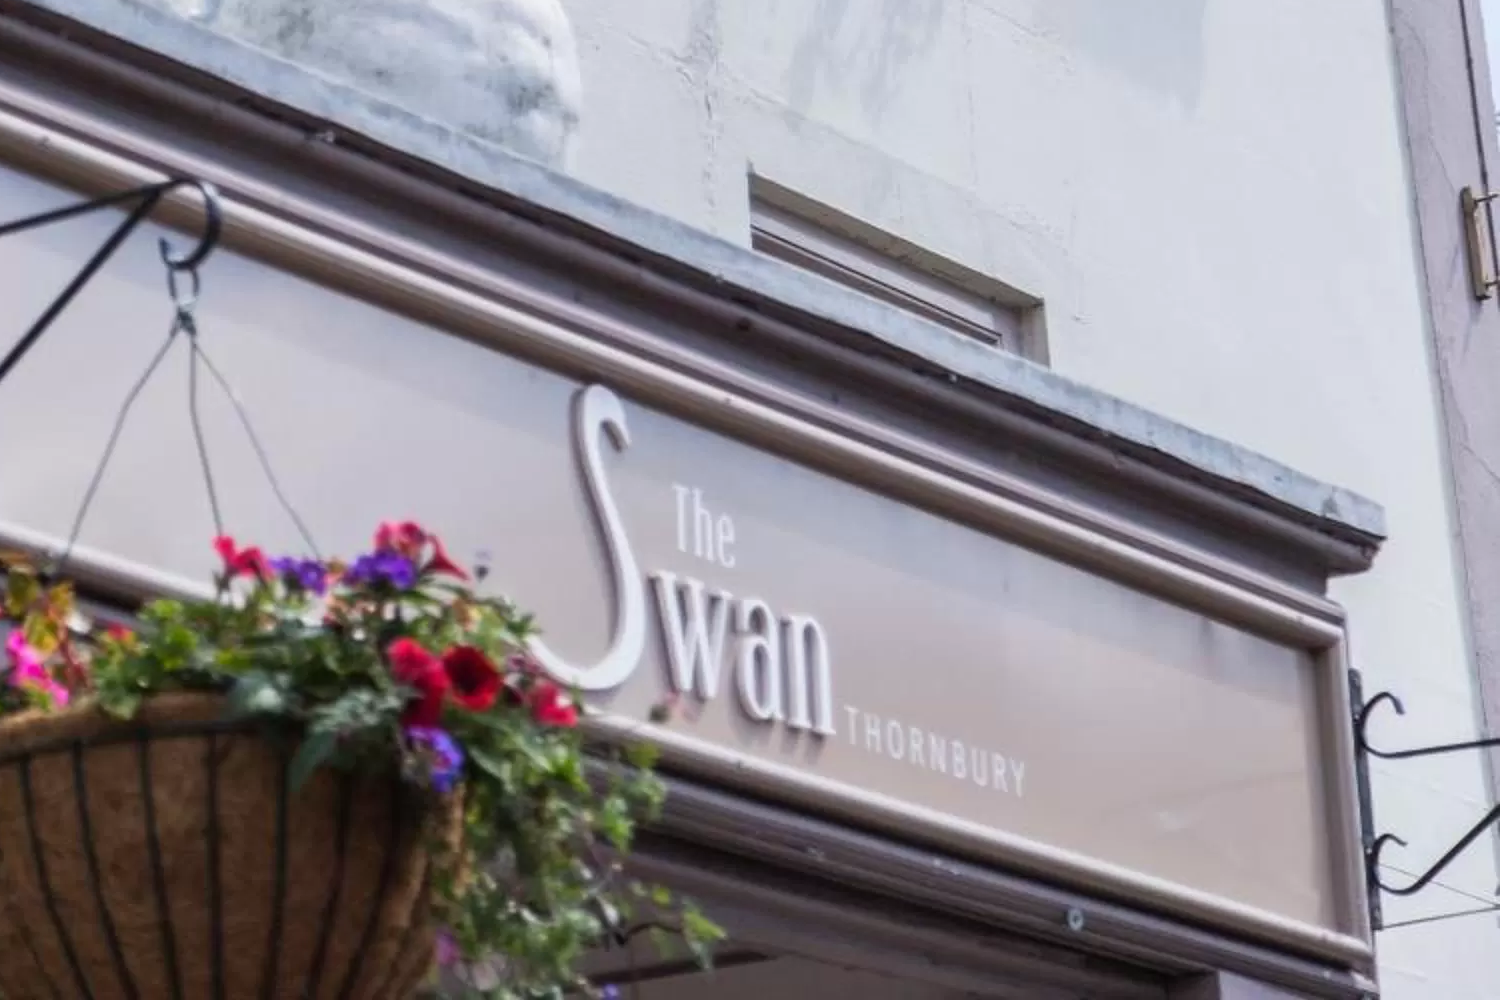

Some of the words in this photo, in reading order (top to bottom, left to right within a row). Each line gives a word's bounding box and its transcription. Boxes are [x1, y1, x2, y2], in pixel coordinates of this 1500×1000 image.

[525, 384, 836, 737] Swan
[672, 482, 736, 568] The
[843, 704, 1025, 799] THORNBURY
